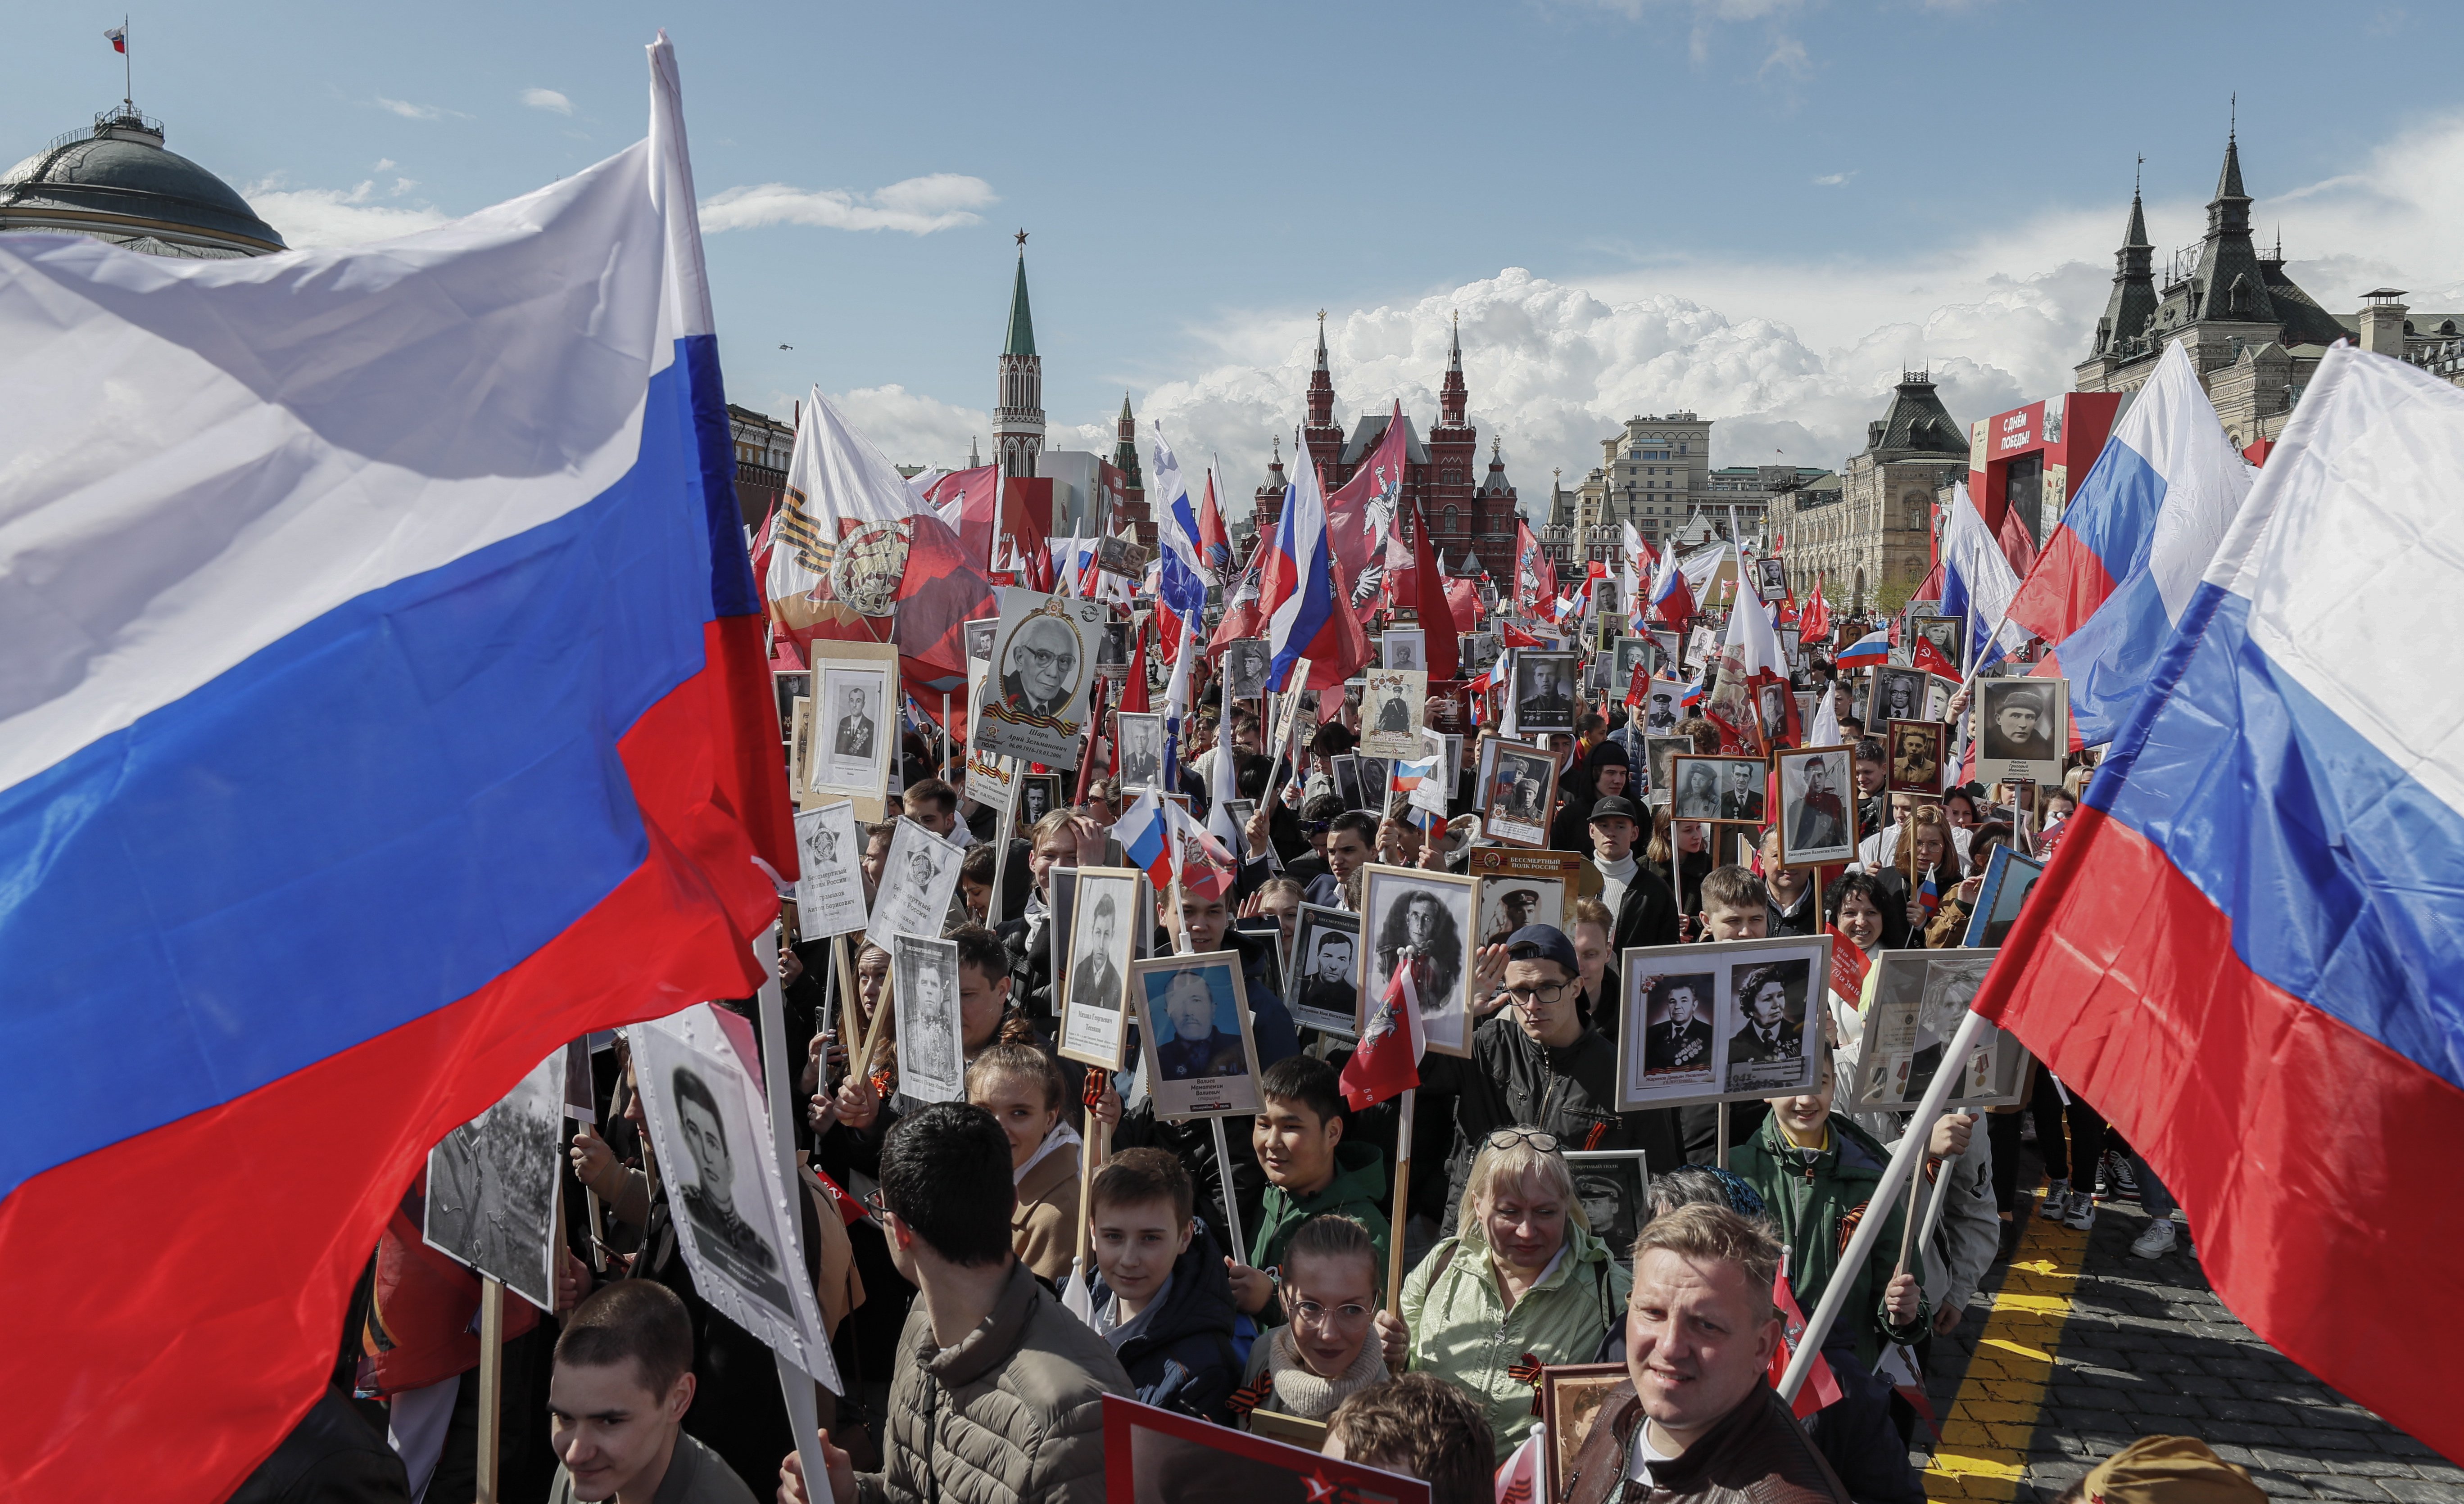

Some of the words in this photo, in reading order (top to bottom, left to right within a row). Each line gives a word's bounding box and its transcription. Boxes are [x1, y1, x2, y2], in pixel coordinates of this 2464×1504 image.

[2003, 419, 2008, 431] С
[2007, 411, 2027, 433] ДНЁМ
[2001, 430, 2030, 450] ПОБЕДЫ!
[1029, 729, 1050, 739] Шарц
[1007, 734, 1024, 743] Арий
[1026, 737, 1068, 752] Зельманович
[1009, 743, 1062, 759] 06.09.1916-19.03.2006
[807, 867, 847, 881] Бессмертный
[827, 877, 847, 886] России
[825, 899, 855, 909] Борисович
[907, 902, 927, 919] России
[1831, 967, 1841, 977] 79
[1329, 1013, 1354, 1022] Васильевич
